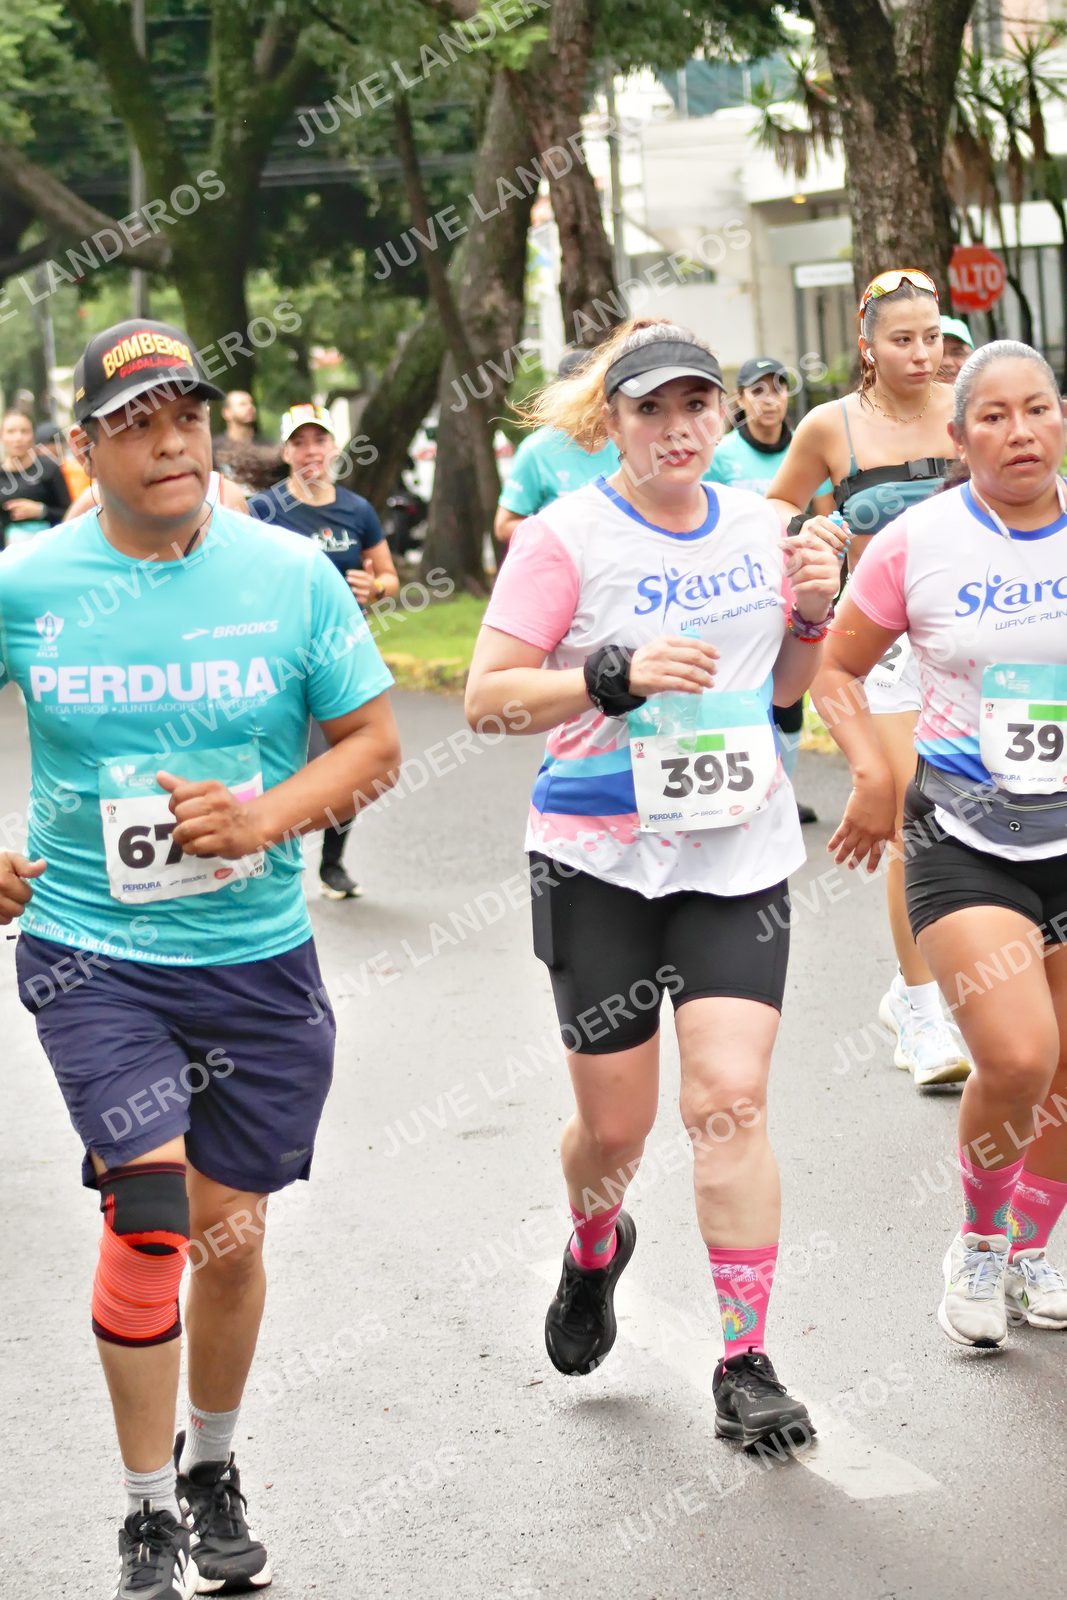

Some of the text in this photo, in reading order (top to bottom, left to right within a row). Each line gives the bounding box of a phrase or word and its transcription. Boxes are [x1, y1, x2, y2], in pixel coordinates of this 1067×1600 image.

[955, 564, 1067, 627] Starc
[680, 598, 778, 631] WAVE RUNNERS
[995, 615, 1036, 631] WAVE
[212, 619, 279, 639] BROOKS
[29, 656, 278, 704] PERDURA
[44, 704, 71, 714] PEGA
[73, 704, 109, 714] PISOS
[661, 752, 754, 799] 395
[649, 812, 684, 821] PERDURA
[122, 881, 162, 893] PERDURA
[67, 931, 75, 945] y
